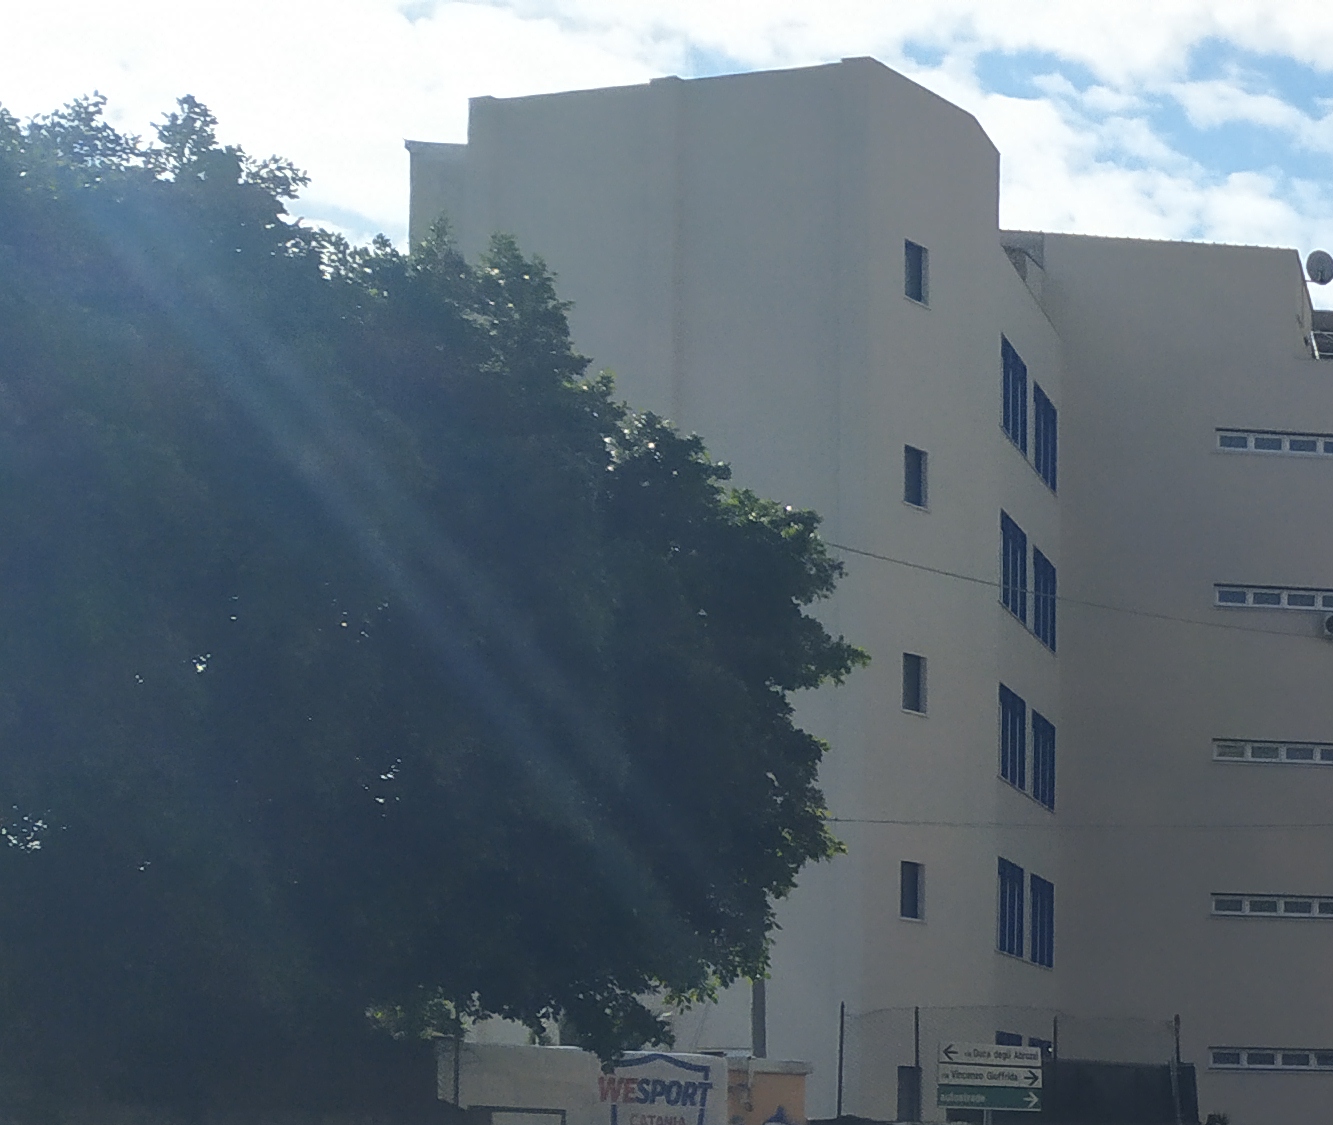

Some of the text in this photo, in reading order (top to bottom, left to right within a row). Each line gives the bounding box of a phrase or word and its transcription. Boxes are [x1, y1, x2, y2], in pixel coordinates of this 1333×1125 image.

[973, 1048, 991, 1058] Duca
[993, 1050, 1011, 1061] degli
[950, 1069, 984, 1080] Vincenzo
[598, 1077, 713, 1107] WESPORT
